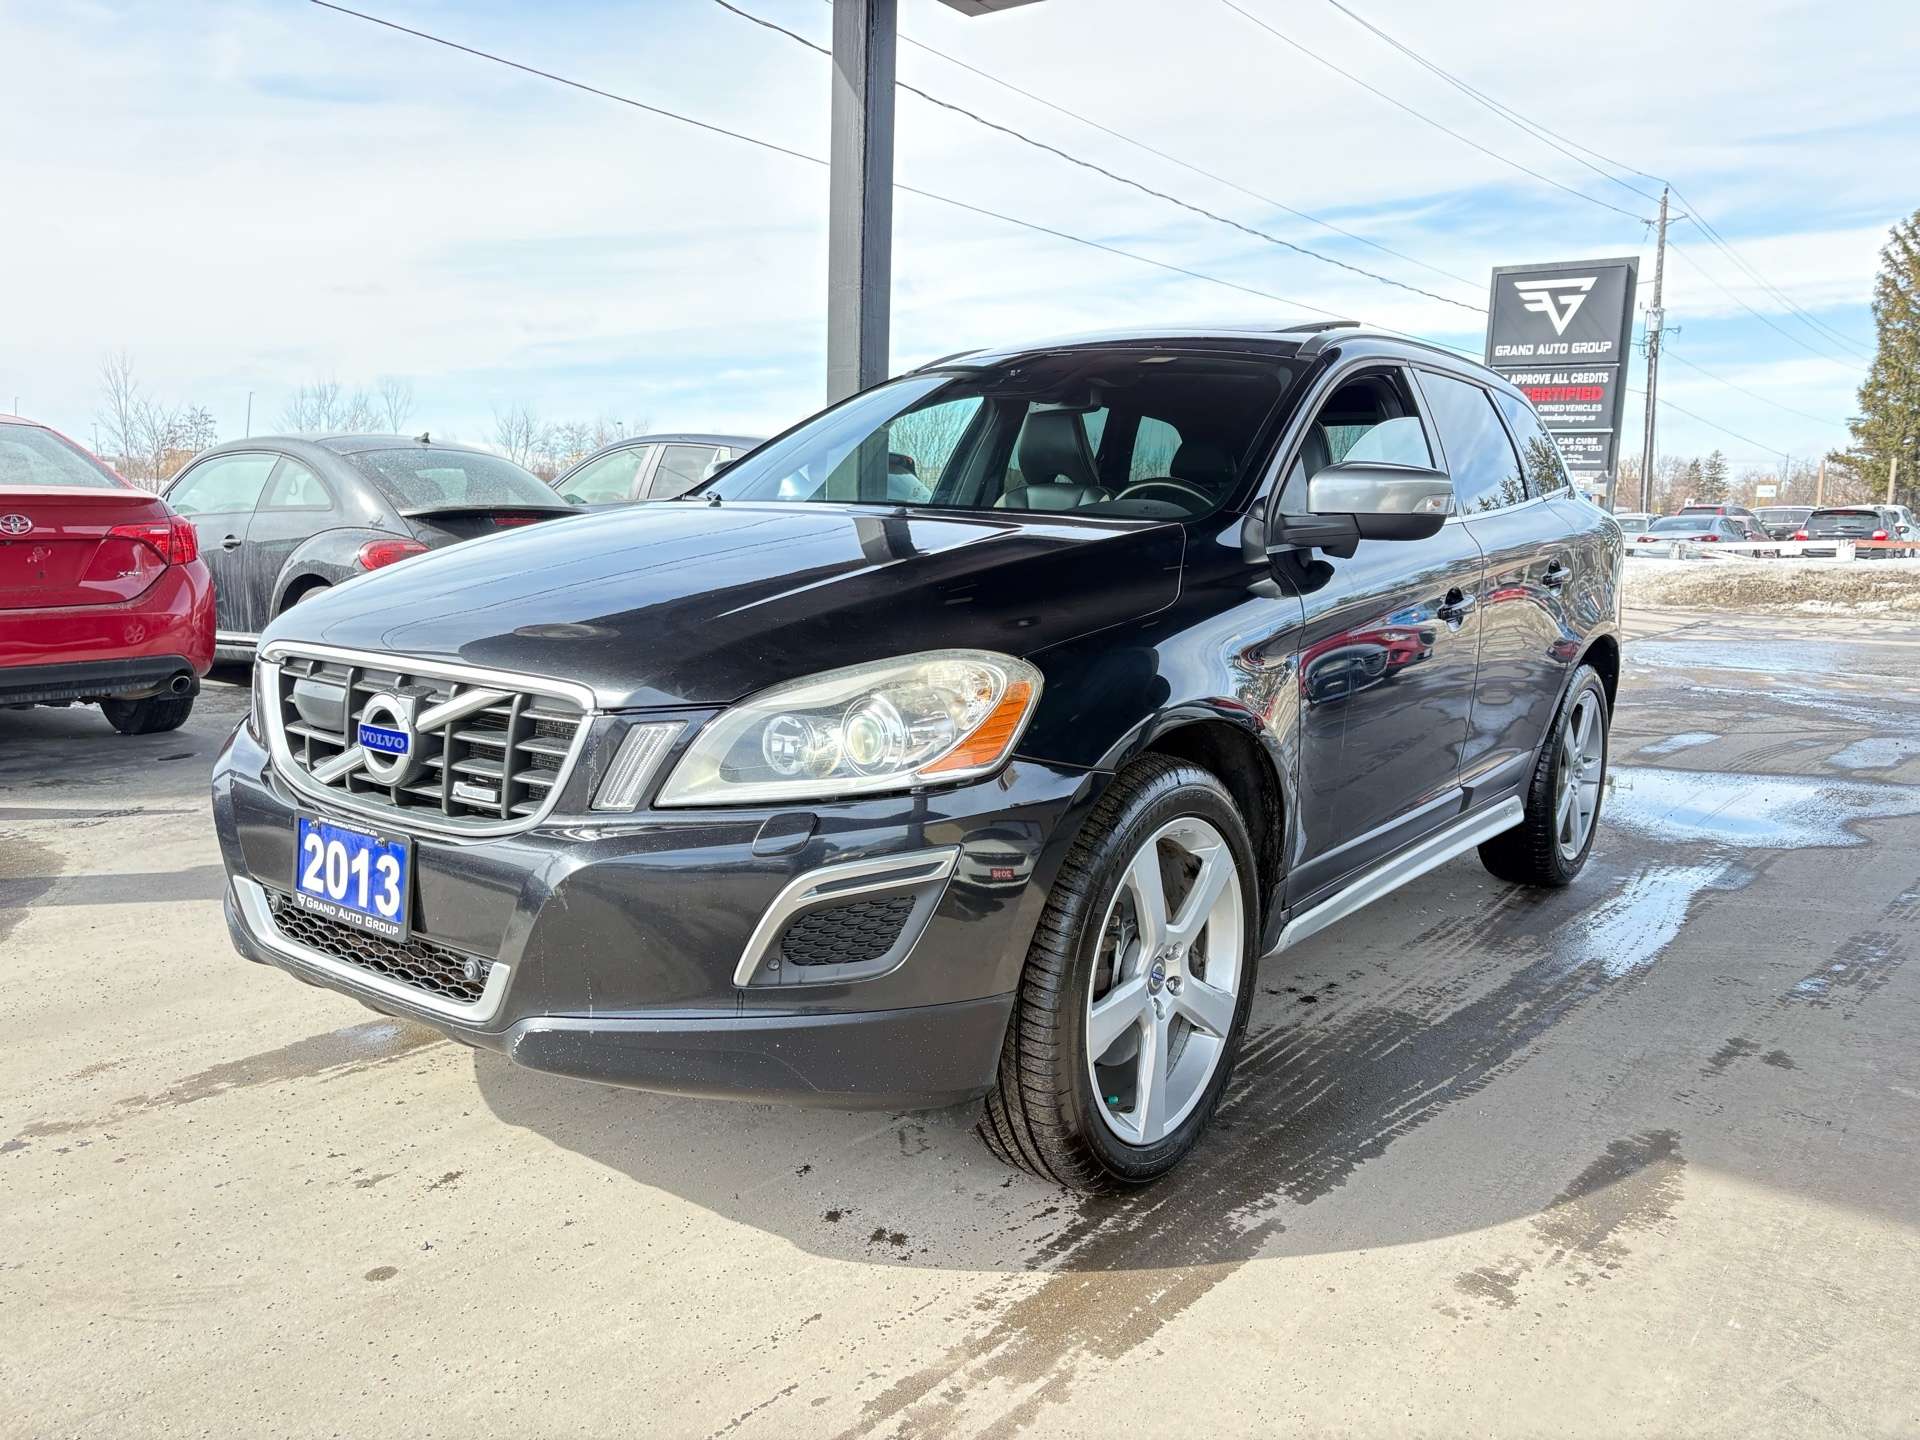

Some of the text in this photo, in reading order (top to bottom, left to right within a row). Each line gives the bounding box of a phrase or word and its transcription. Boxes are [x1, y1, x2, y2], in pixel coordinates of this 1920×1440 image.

[1495, 341, 1612, 357] GRAND AUTO GROUP
[1510, 373, 1551, 385] APPROVE
[1551, 373, 1569, 385] ALL
[1570, 372, 1609, 384] CREDITS
[1537, 404, 1603, 412] OWNED VEHICLES
[360, 730, 405, 749] VOLVO
[301, 832, 401, 918] 2013
[306, 896, 399, 936] GRAND AUTO GROUP
